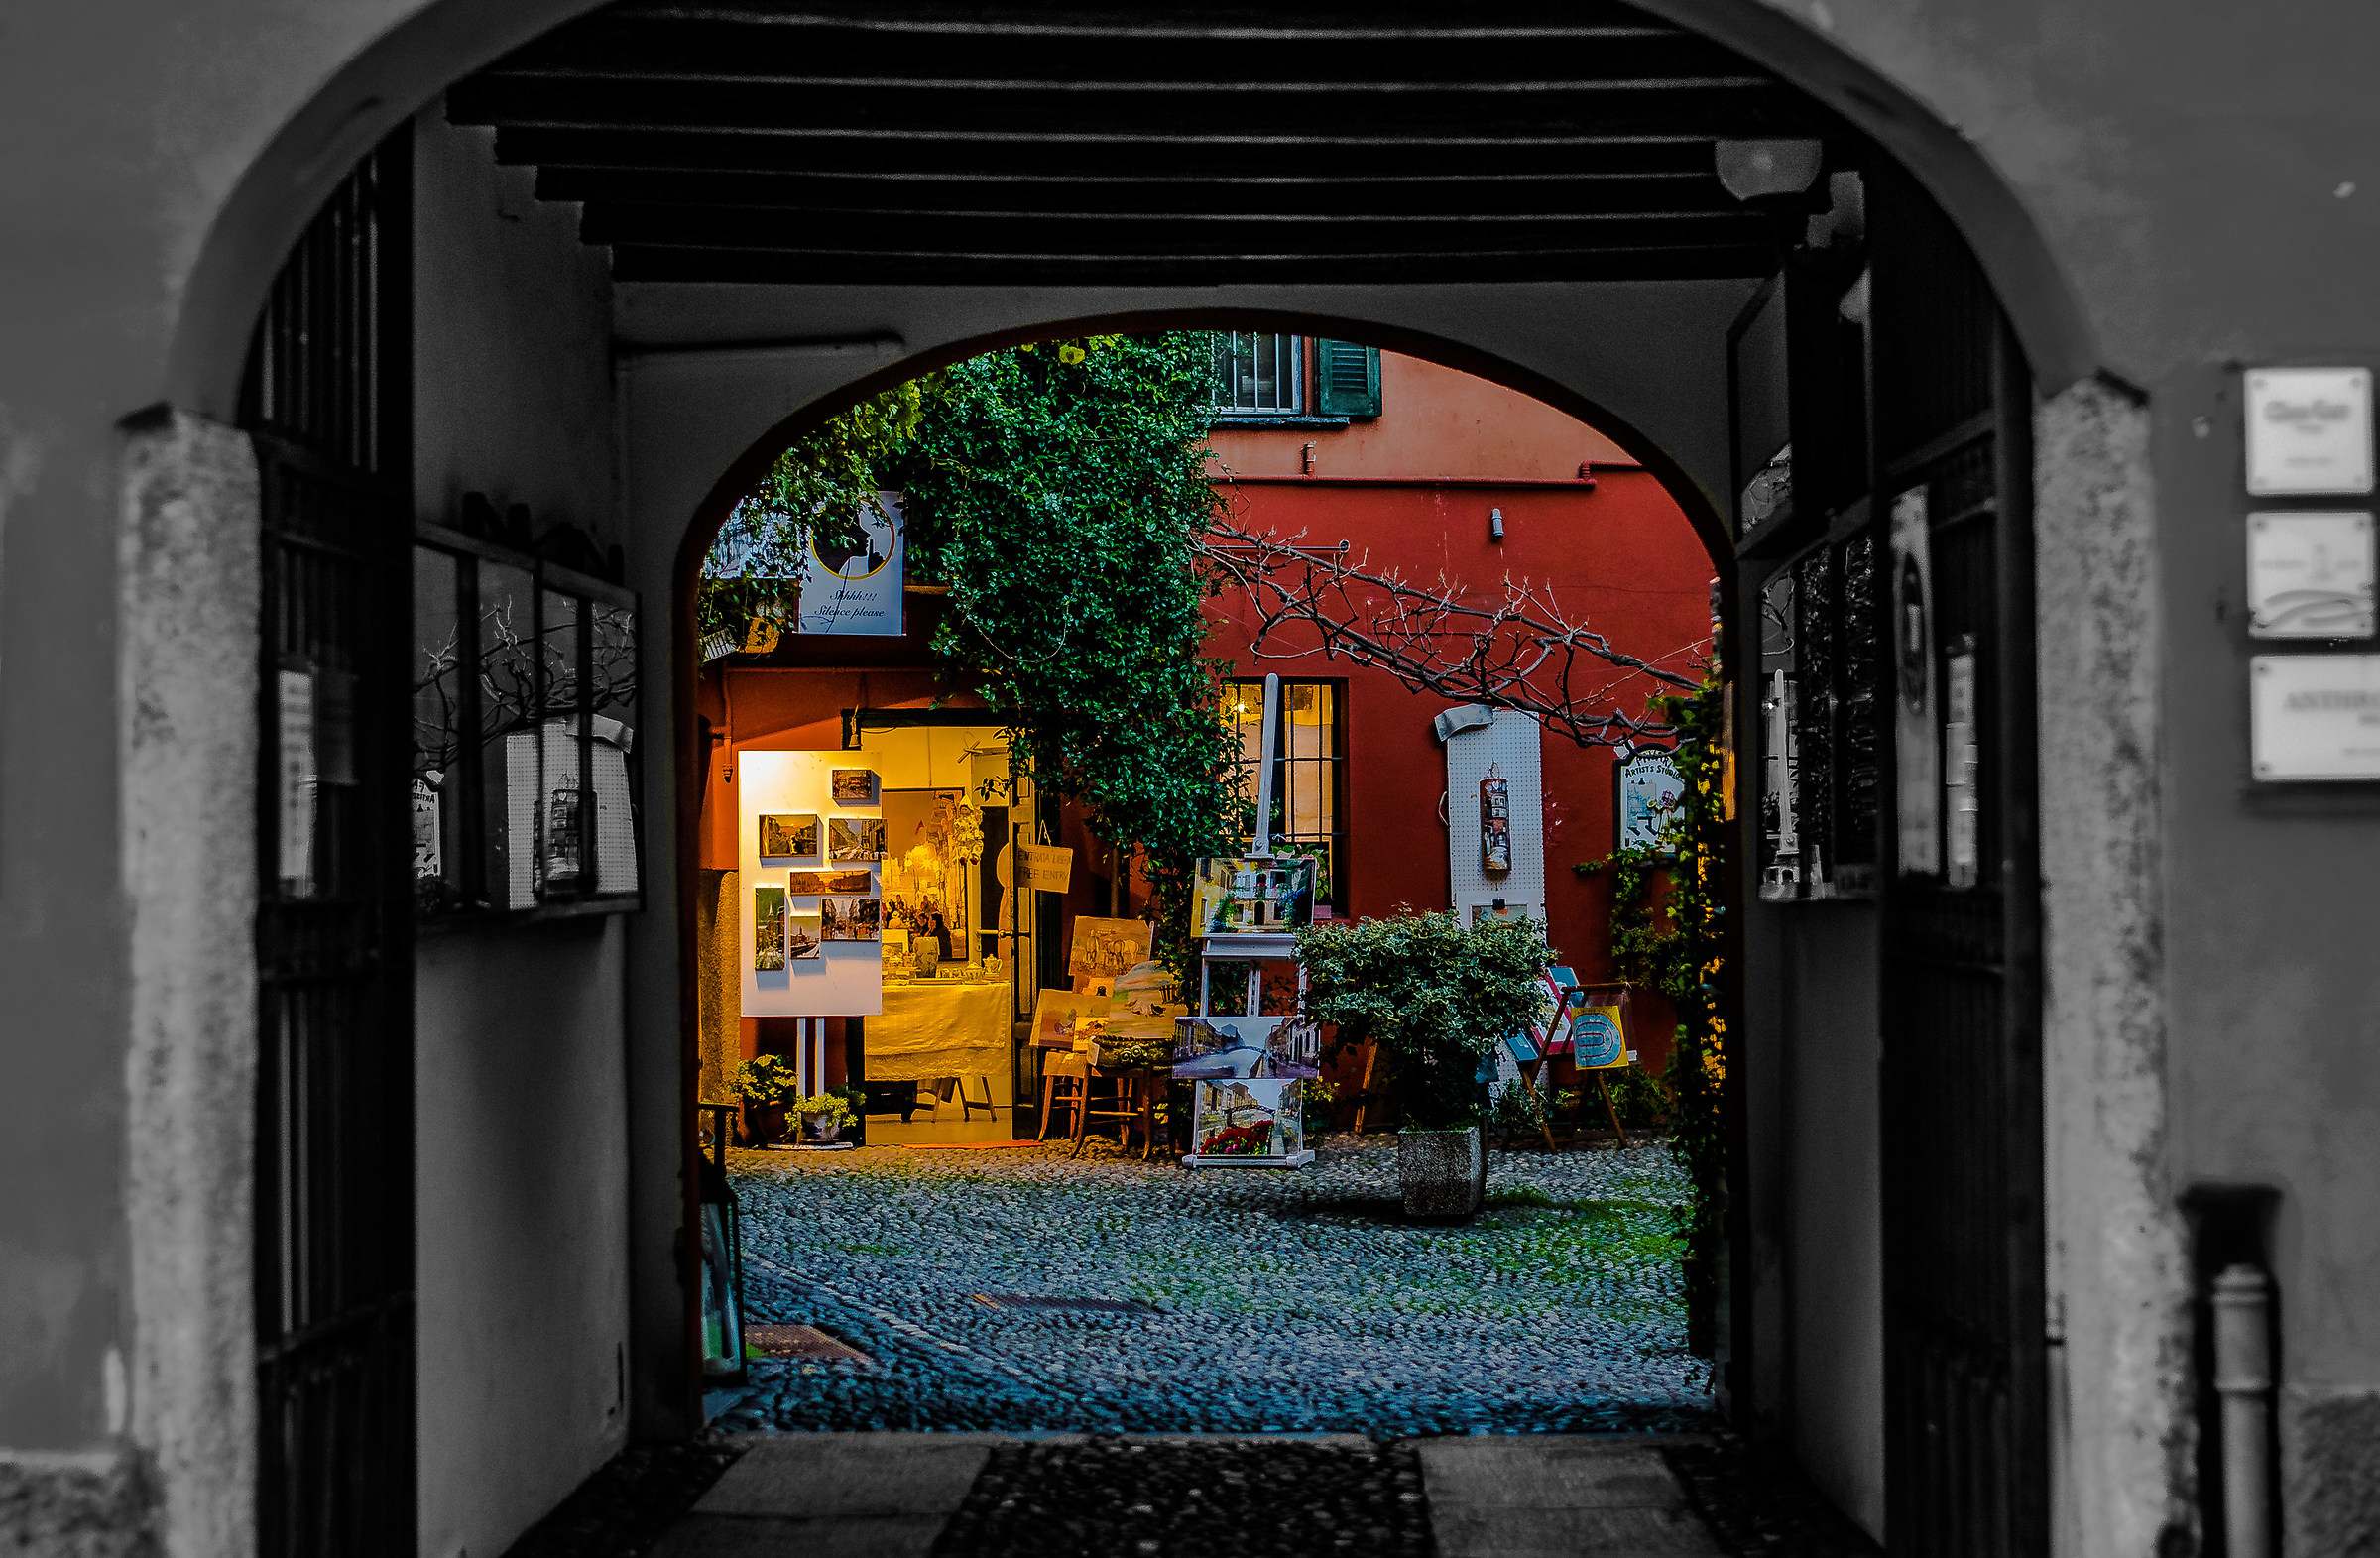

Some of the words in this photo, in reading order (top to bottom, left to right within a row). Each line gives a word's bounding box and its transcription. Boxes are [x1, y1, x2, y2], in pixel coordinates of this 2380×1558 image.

[814, 604, 851, 616] Silence
[850, 606, 886, 620] please
[1625, 764, 1654, 778] ARTIST'S
[1656, 765, 1681, 779] STUDIO
[1017, 850, 1050, 863] ENTRATA
[1018, 866, 1039, 880] FREE
[1042, 870, 1069, 882] ENTRY
